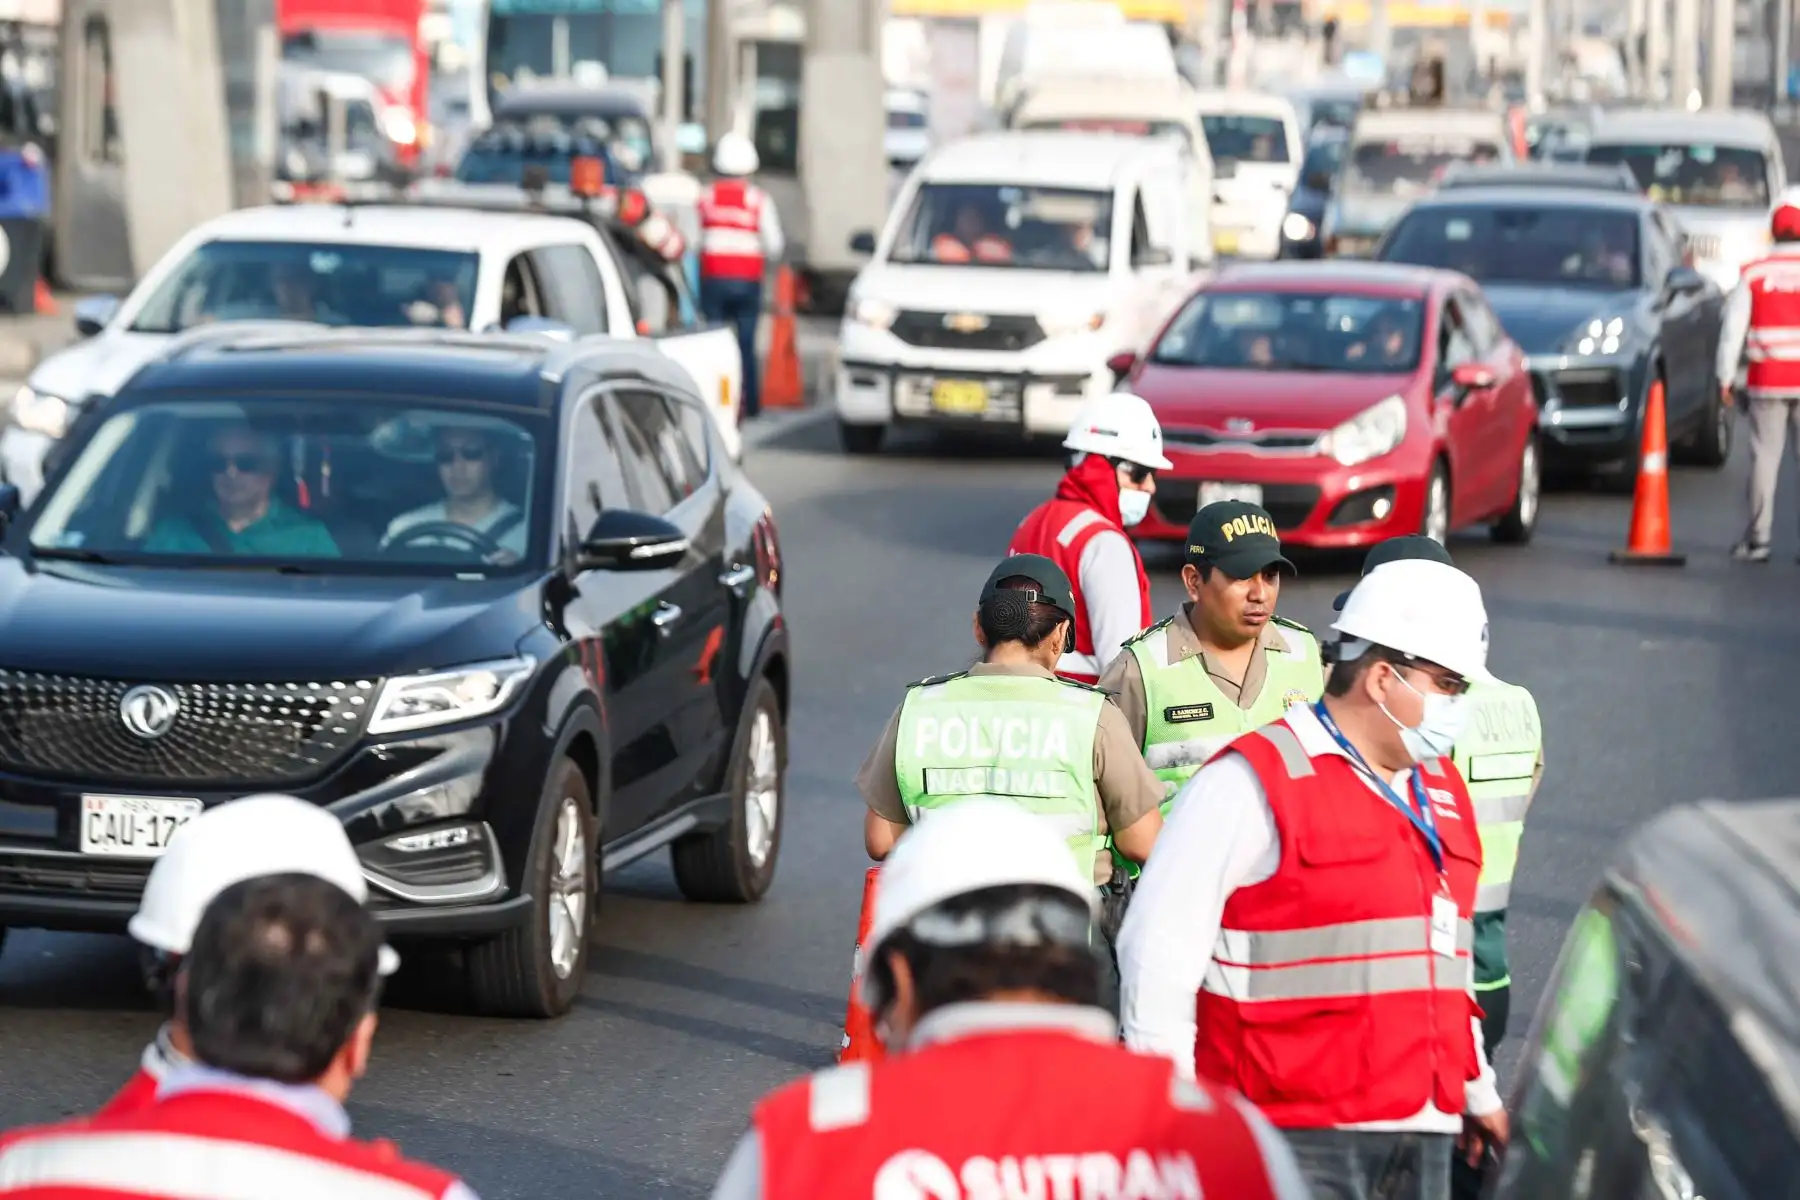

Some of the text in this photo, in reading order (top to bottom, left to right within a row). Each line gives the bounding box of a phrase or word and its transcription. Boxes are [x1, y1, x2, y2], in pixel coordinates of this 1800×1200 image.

[1221, 514, 1280, 543] POLICIA
[1189, 544, 1205, 554] PERU
[1471, 699, 1537, 742] OLICIA
[915, 715, 1070, 759] POLICIA
[928, 767, 1066, 796] NACIONAL
[88, 812, 191, 848] CAU-17
